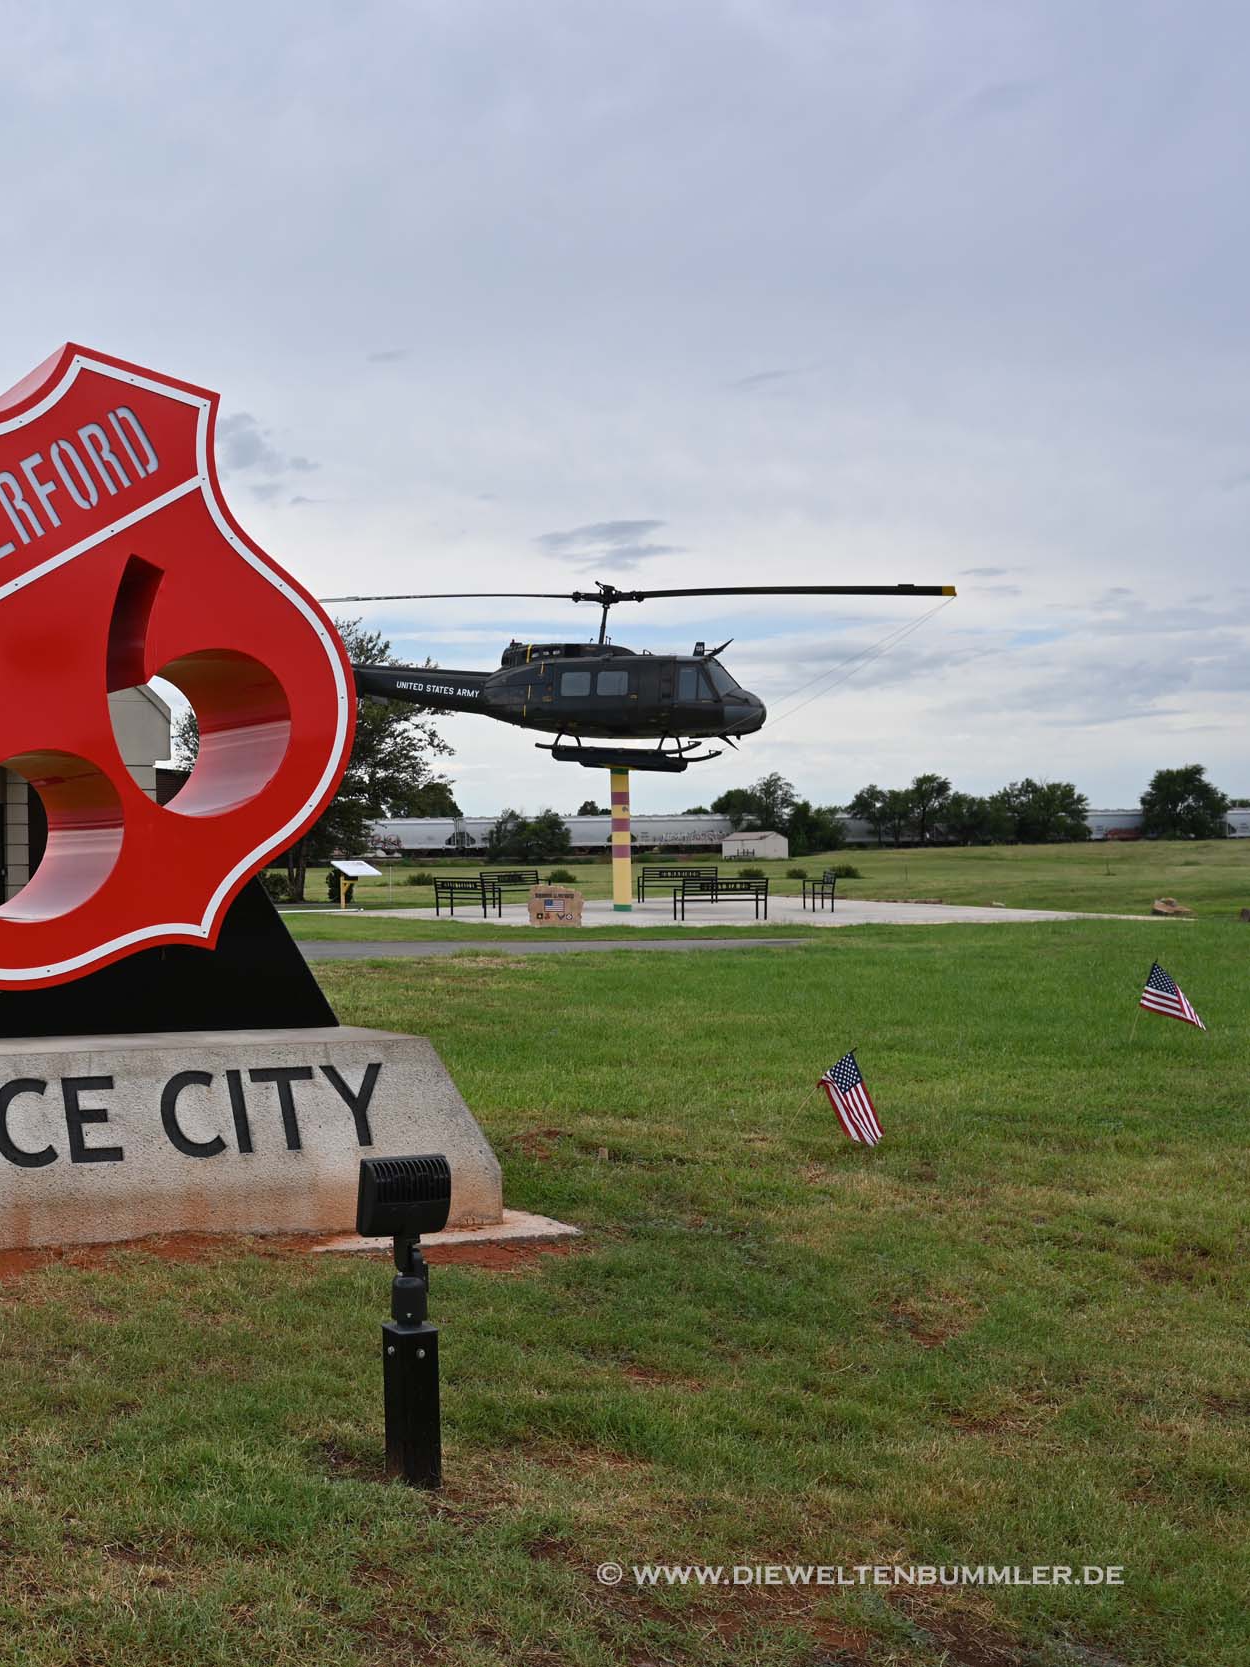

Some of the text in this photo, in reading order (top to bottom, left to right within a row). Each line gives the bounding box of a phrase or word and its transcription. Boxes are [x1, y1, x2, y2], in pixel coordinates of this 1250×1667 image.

[396, 681, 480, 698] UNITED STATES ARMY
[159, 1062, 382, 1158] CITY
